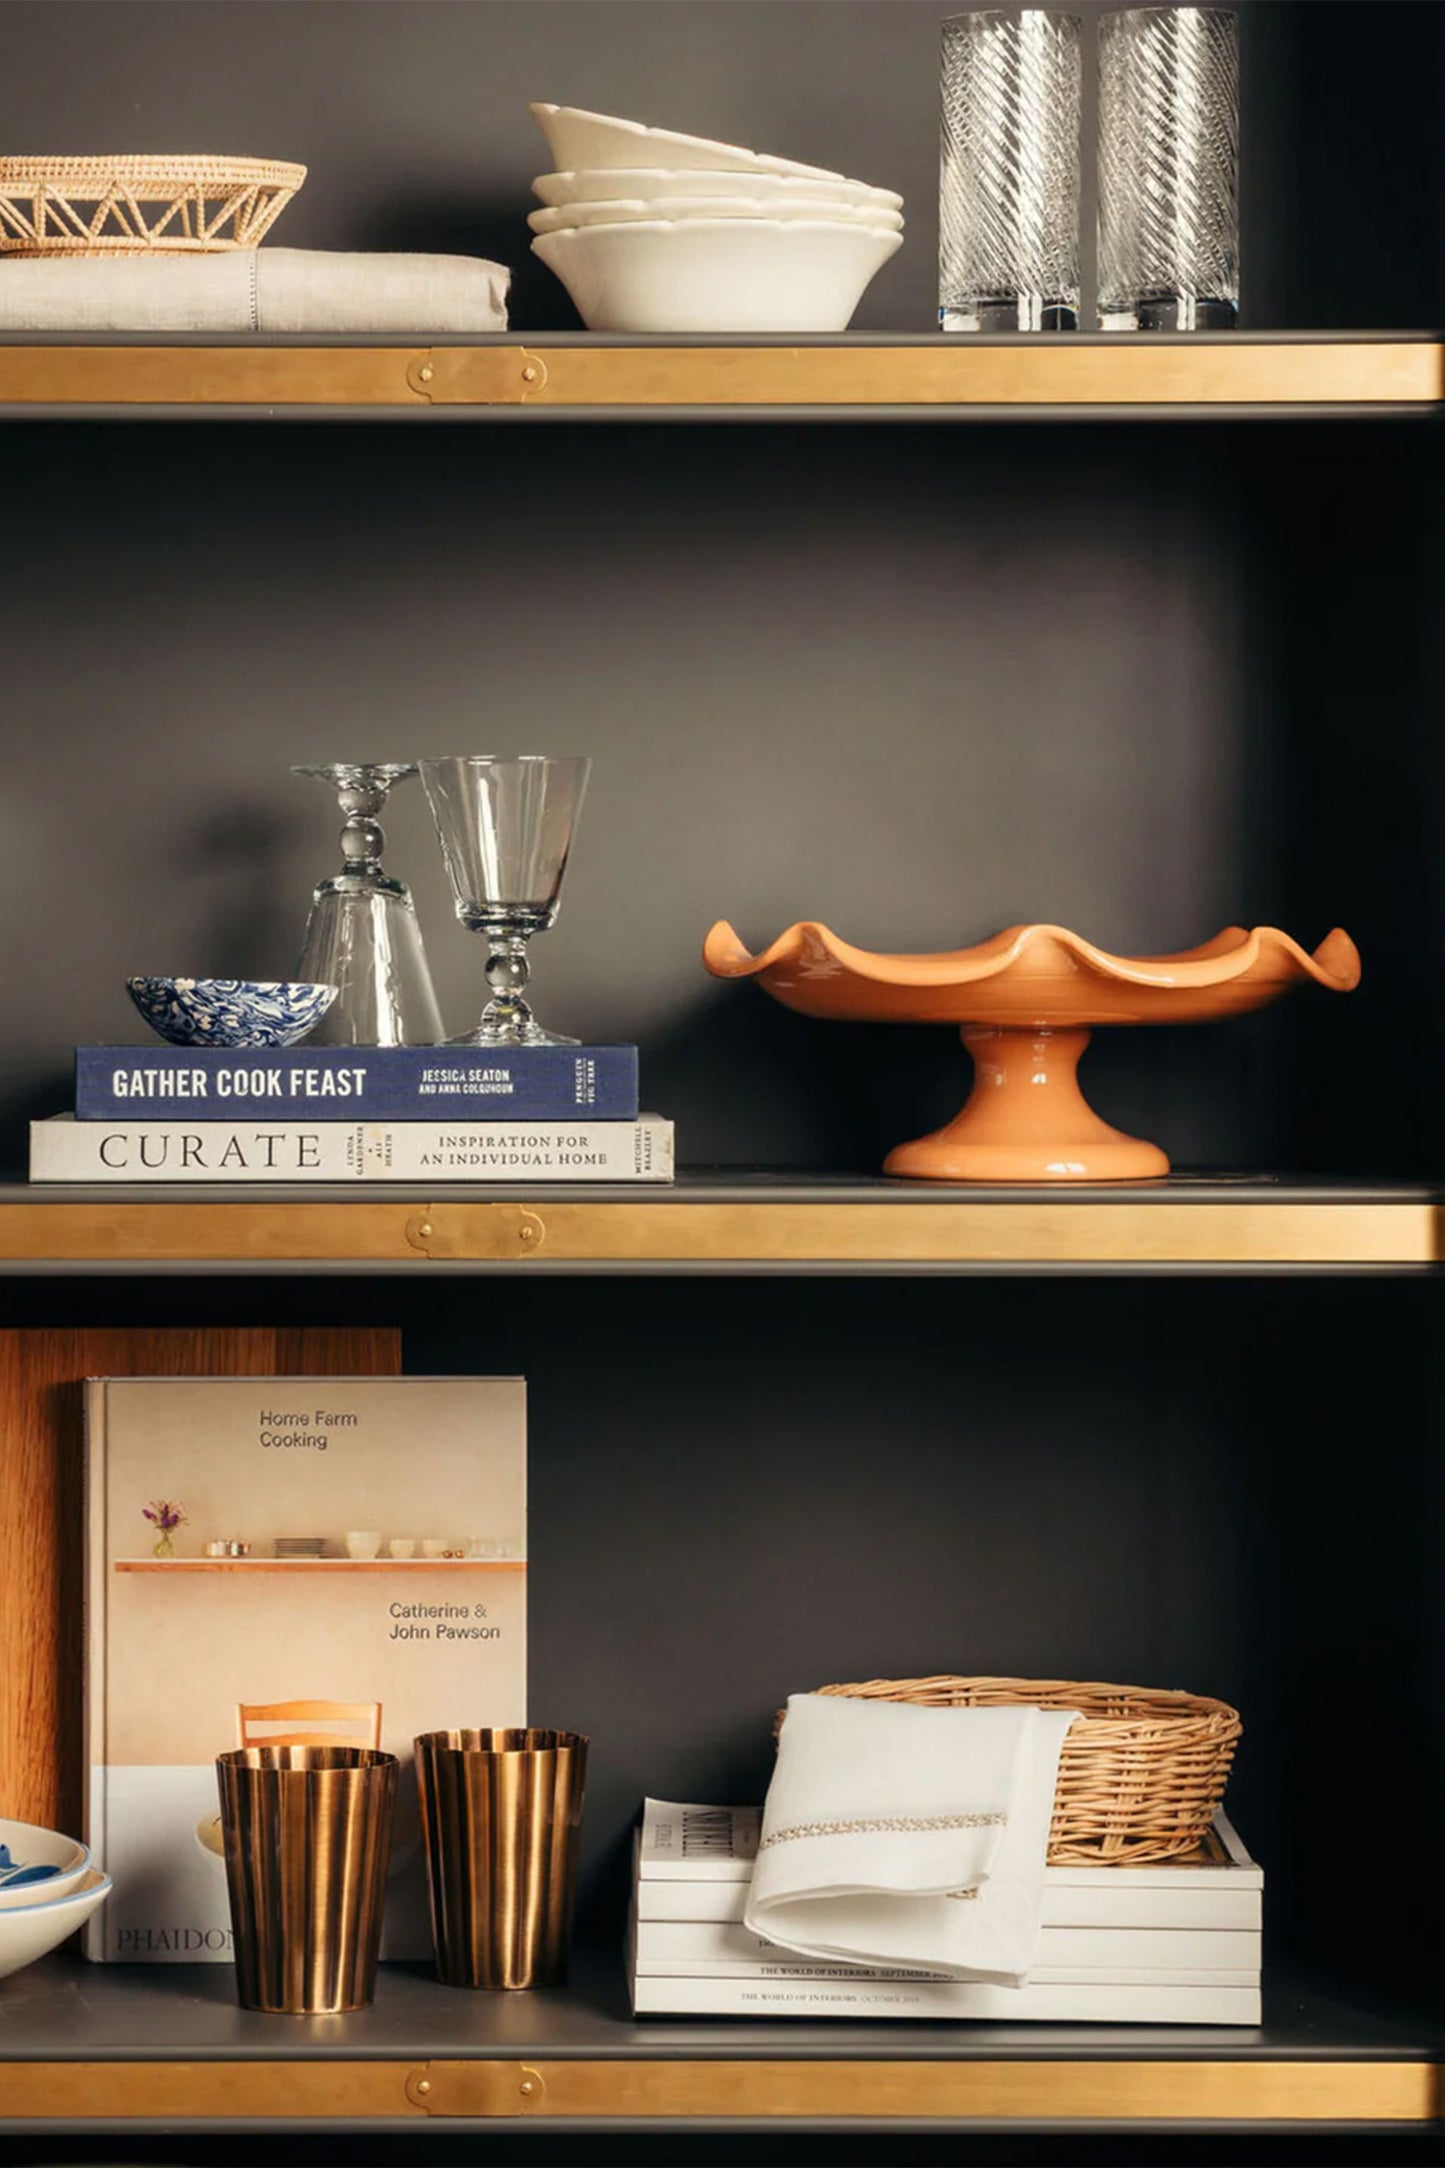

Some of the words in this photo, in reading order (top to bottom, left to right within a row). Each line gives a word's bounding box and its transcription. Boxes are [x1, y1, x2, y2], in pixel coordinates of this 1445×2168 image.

[112, 1069, 208, 1098] GATHER
[216, 1069, 283, 1097] COOK
[290, 1068, 367, 1096] FEAST
[422, 1069, 467, 1083] JESSICA
[468, 1069, 510, 1082] SEATON
[418, 1084, 436, 1095] AND
[438, 1084, 461, 1095] ANNA
[463, 1083, 514, 1094] COLQUHOUN
[439, 1136, 551, 1147] INSPIRATION
[556, 1136, 589, 1147] FOR
[99, 1133, 322, 1168] CURATE
[356, 1126, 364, 1176] GARDENER
[420, 1153, 443, 1165] AN
[450, 1153, 552, 1165] INDIVIDUAL
[559, 1153, 607, 1165] HOME
[260, 1410, 309, 1426] Home
[315, 1410, 358, 1426] Farm
[260, 1431, 327, 1451] Cooking
[389, 1602, 469, 1618] Catherine
[474, 1603, 487, 1618] &
[389, 1624, 430, 1639] John
[436, 1624, 500, 1639] Pawson
[760, 1967, 779, 1975] THE
[780, 1967, 813, 1976] WORLD
[815, 1968, 827, 1976] OF
[828, 1968, 876, 1977] INTERIORS
[881, 1969, 932, 1978] SEPTEMBER
[742, 1992, 759, 2000] THE
[761, 1993, 794, 2001] WORLD
[795, 1993, 807, 2001] OF
[809, 1994, 857, 2002] INTERIORS
